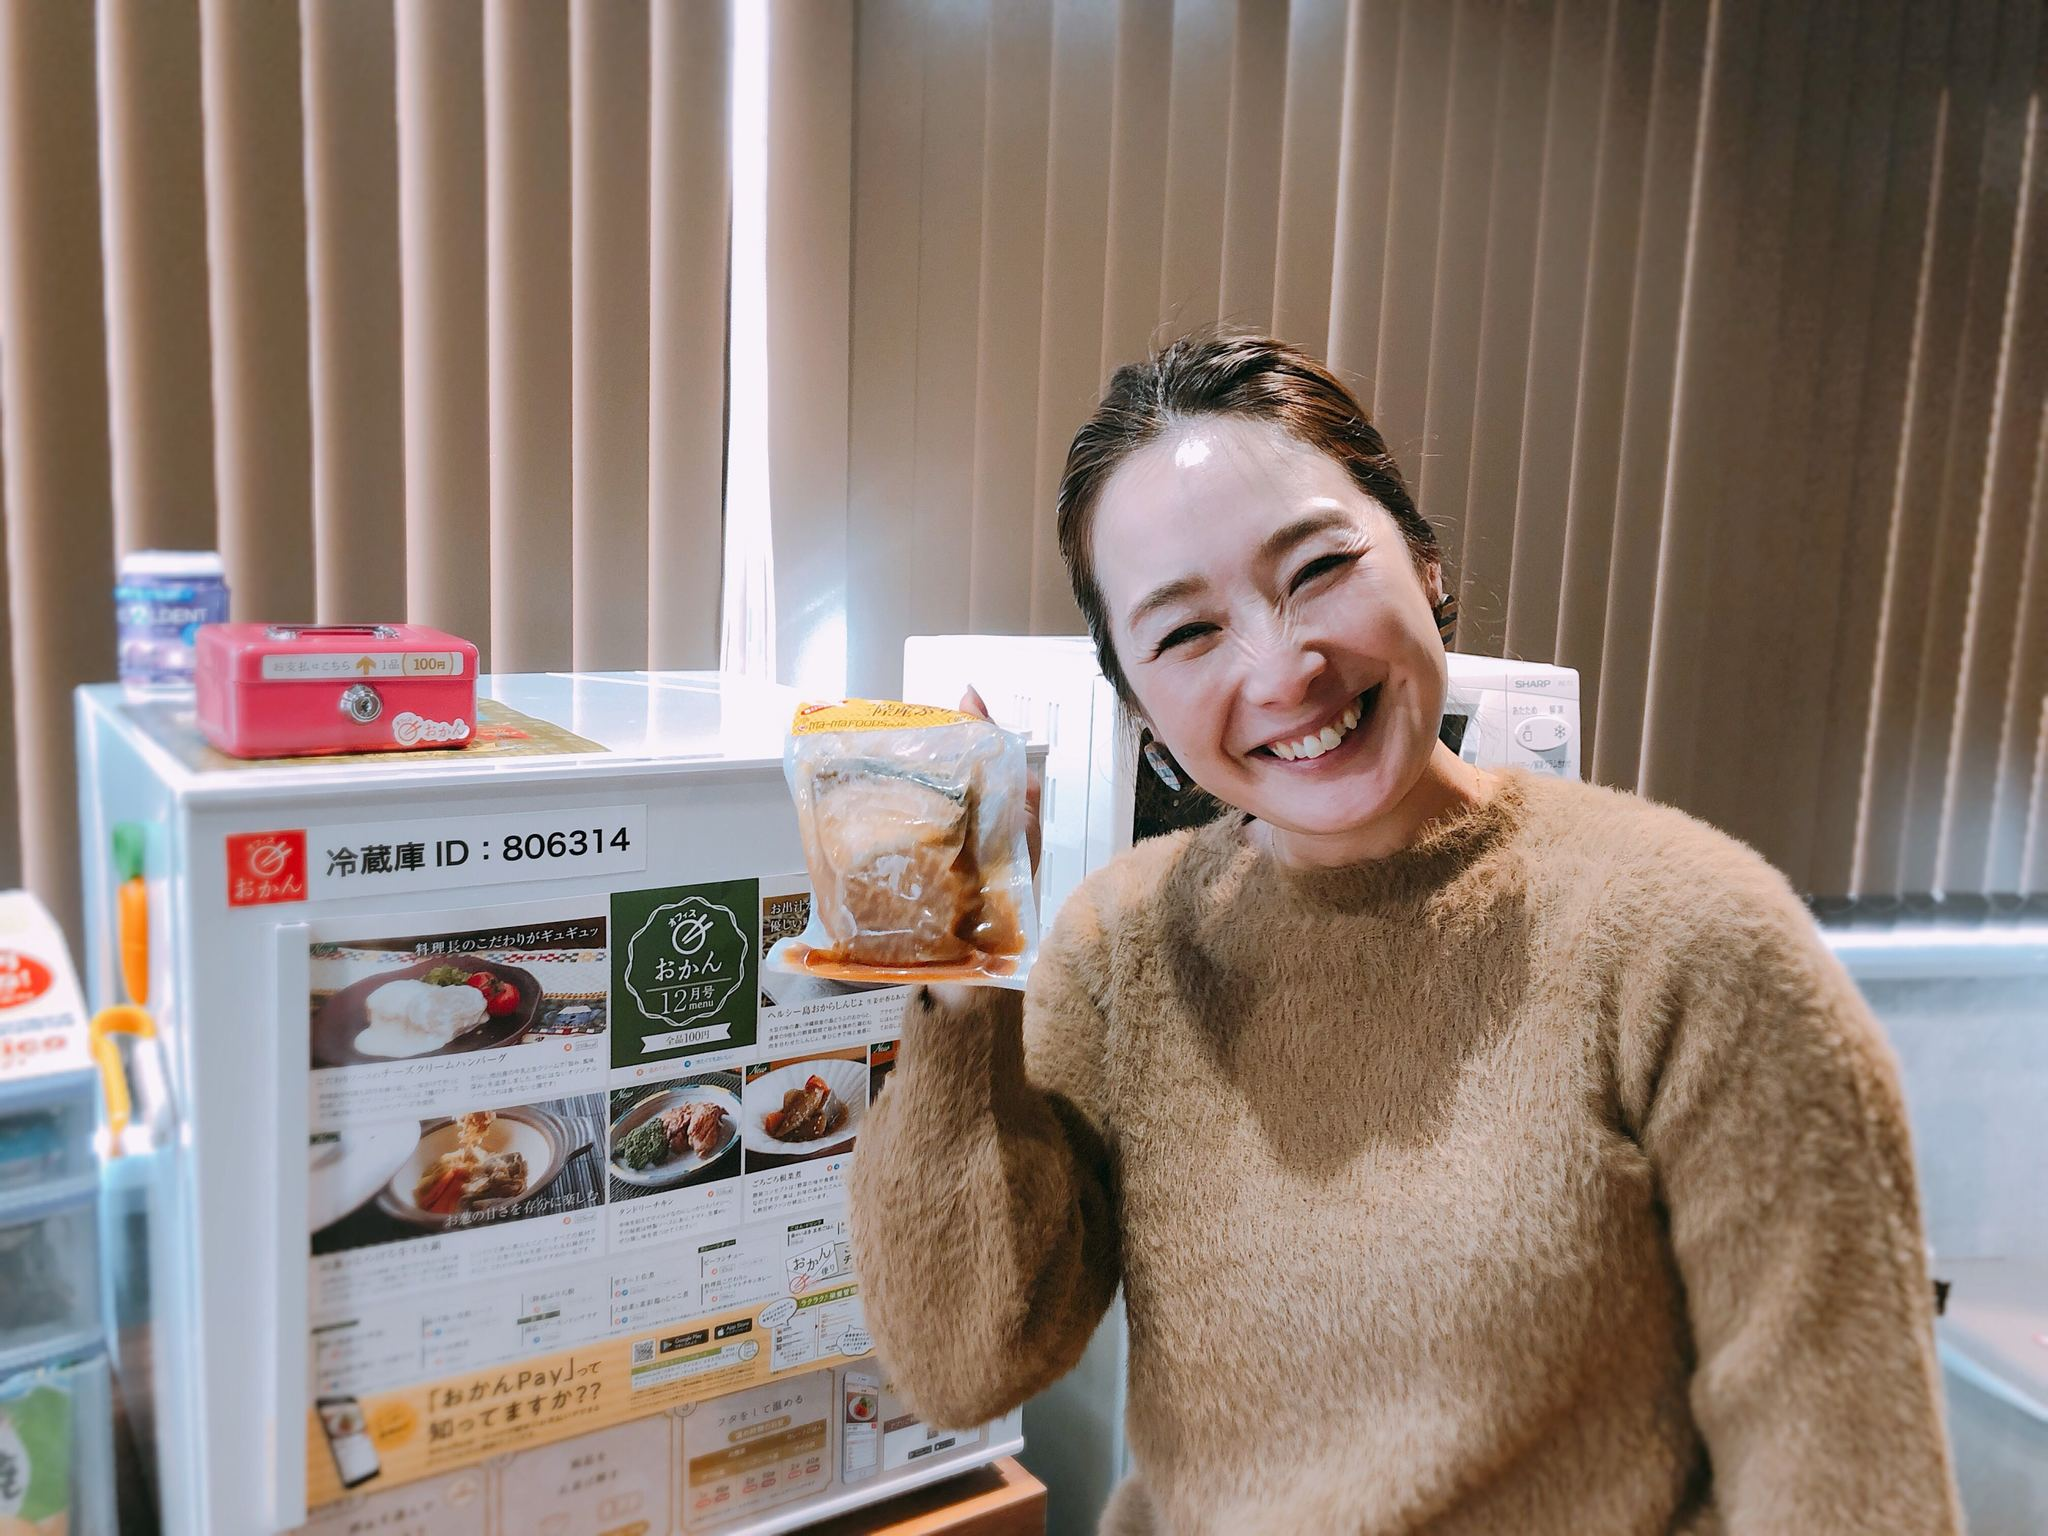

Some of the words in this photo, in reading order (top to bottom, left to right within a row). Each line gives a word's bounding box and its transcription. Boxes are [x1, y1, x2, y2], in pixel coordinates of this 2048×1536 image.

[413, 658, 445, 670] 100円
[1515, 680, 1551, 689] SHARP
[1512, 705, 1538, 715] あたため
[424, 721, 465, 738] おかん
[235, 874, 303, 899] おかん
[668, 909, 697, 928] オフィス
[415, 926, 599, 956] 料理長のこだわりがギュギュッ
[654, 950, 722, 982] おかん
[688, 999, 714, 1011] menu
[768, 999, 863, 1020] ヘルシー島おからしんじょ
[666, 1029, 710, 1047] 全品100円
[873, 1041, 891, 1054] New
[749, 1064, 767, 1076] New
[612, 1088, 634, 1102] New
[793, 1247, 831, 1271] おかん
